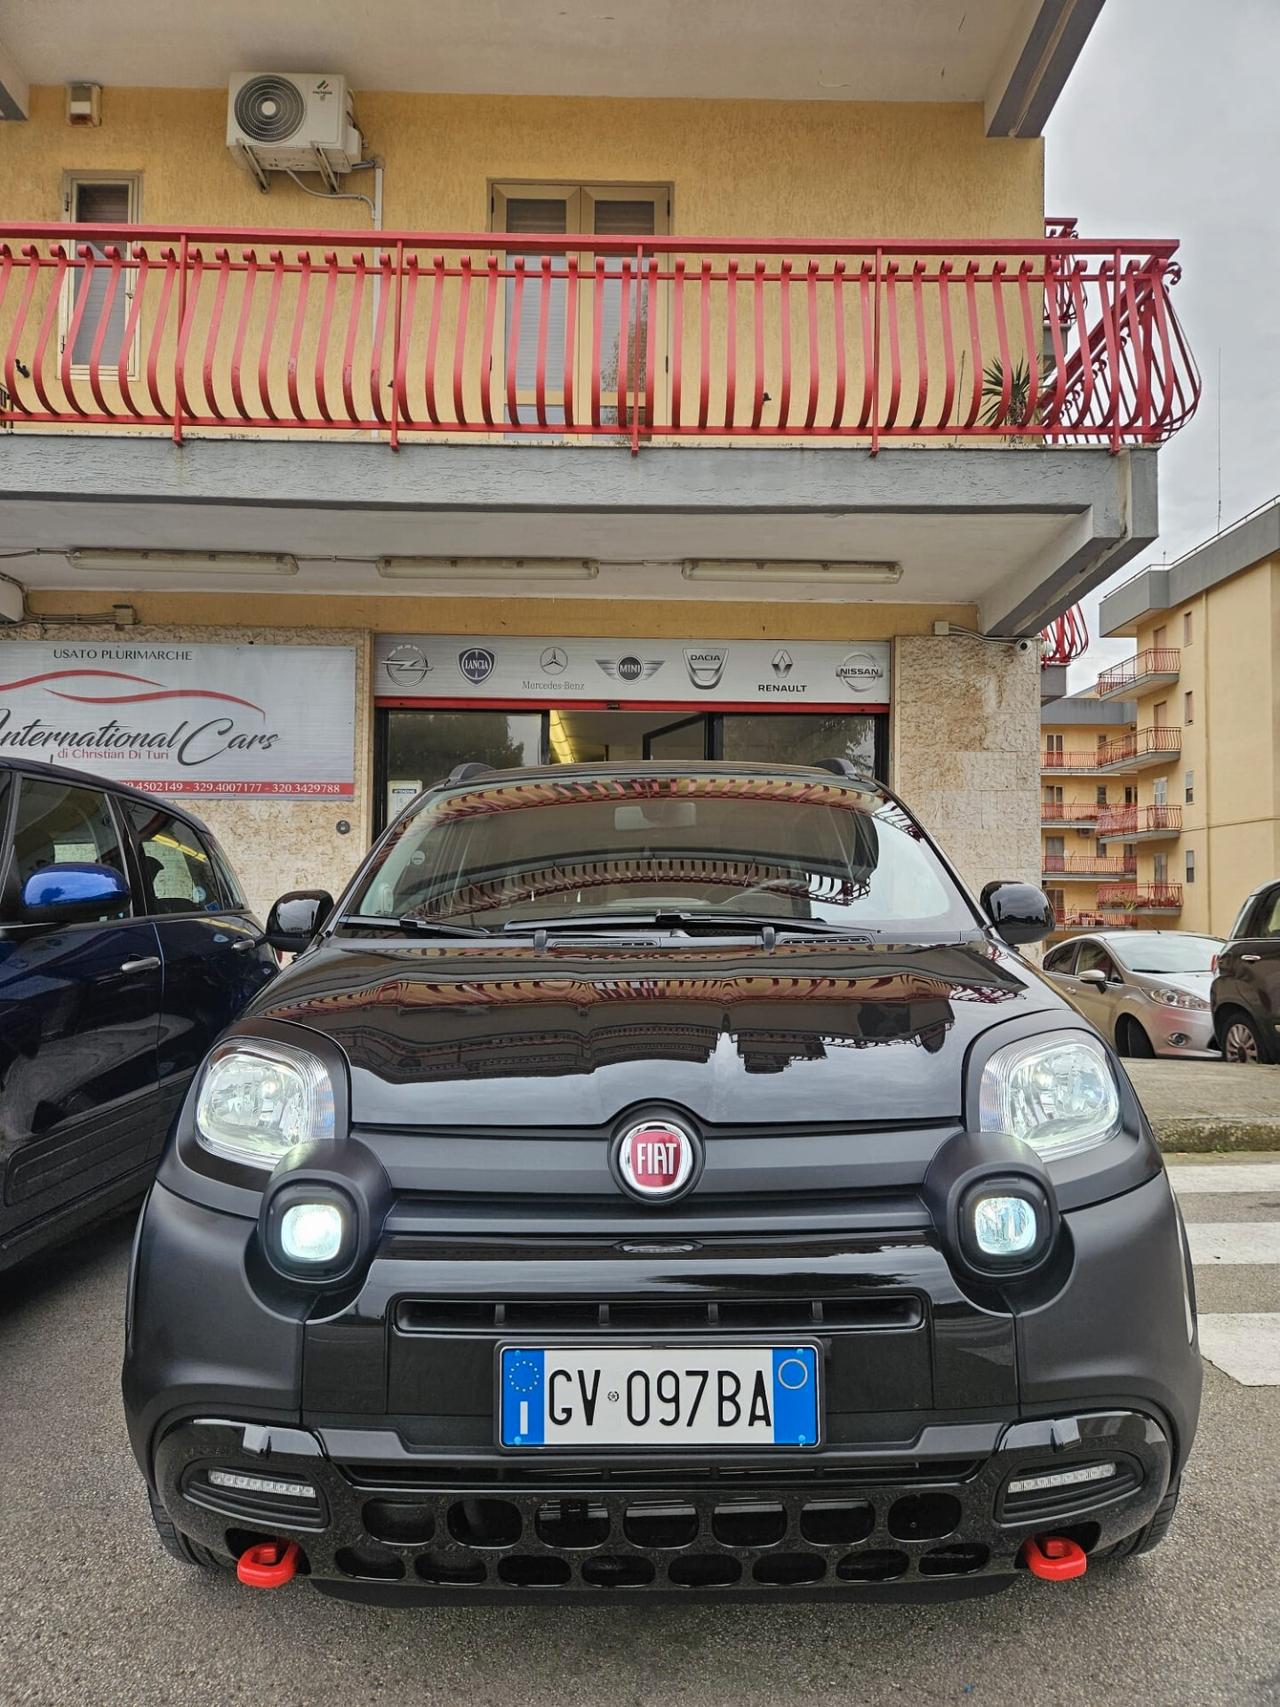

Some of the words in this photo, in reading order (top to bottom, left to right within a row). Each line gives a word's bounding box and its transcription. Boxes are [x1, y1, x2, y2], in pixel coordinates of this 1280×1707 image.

[53, 648, 98, 661] USATO
[100, 649, 193, 662] PLURIMARCHE
[690, 654, 720, 662] DACIA
[464, 658, 488, 671] LANCIA
[618, 664, 641, 674] MINI
[839, 667, 879, 677] NISSAN
[521, 680, 585, 691] Mercedes-Benz
[758, 684, 807, 693] RENAULT
[177, 717, 281, 767] Cars
[57, 749, 69, 759] di
[71, 750, 124, 760] Christian
[128, 750, 142, 760] Di
[147, 750, 169, 760] Turi
[193, 782, 262, 793] 329.4007177
[272, 783, 340, 793] 320.3429788
[637, 1143, 676, 1175] FIAT
[549, 1369, 601, 1426] GV
[626, 1370, 772, 1427] 097BA
